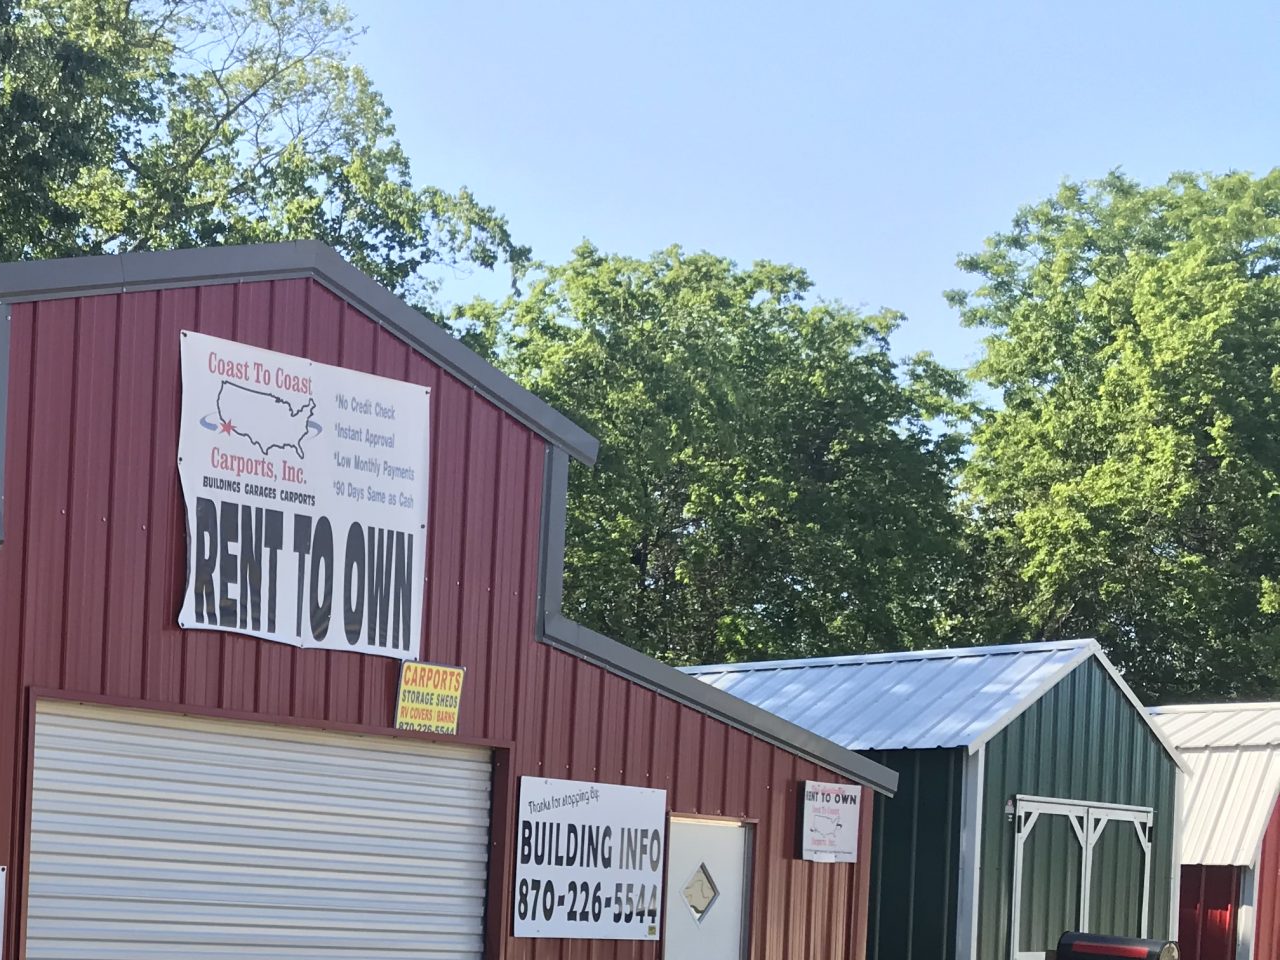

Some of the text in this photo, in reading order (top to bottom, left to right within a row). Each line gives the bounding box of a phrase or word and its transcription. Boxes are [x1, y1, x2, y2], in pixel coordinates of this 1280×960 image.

[208, 351, 312, 395] Coast To Coast
[351, 396, 372, 415] Credit
[375, 401, 395, 420] Check
[365, 428, 395, 448] Approval
[211, 447, 306, 484] Carports, Inc.
[354, 454, 380, 477] Monthly
[383, 460, 414, 481] Payments
[203, 475, 315, 506] BUILDINGS GARAGES CARPORTS
[348, 482, 364, 502] Days
[367, 485, 386, 504] Same
[388, 493, 397, 506] as
[400, 491, 414, 509] Cash
[194, 496, 413, 651] RENT TO OWN
[404, 665, 461, 692] CARPORTS
[402, 690, 458, 709] STORAGE SHEDS
[410, 707, 433, 721] COVERS
[528, 800, 551, 814] Thanks
[562, 790, 590, 808] stopping
[821, 792, 831, 803] TO
[834, 794, 857, 805] OWN
[520, 820, 661, 872] BUILDING INFO
[518, 878, 657, 924] 870-226-5544
